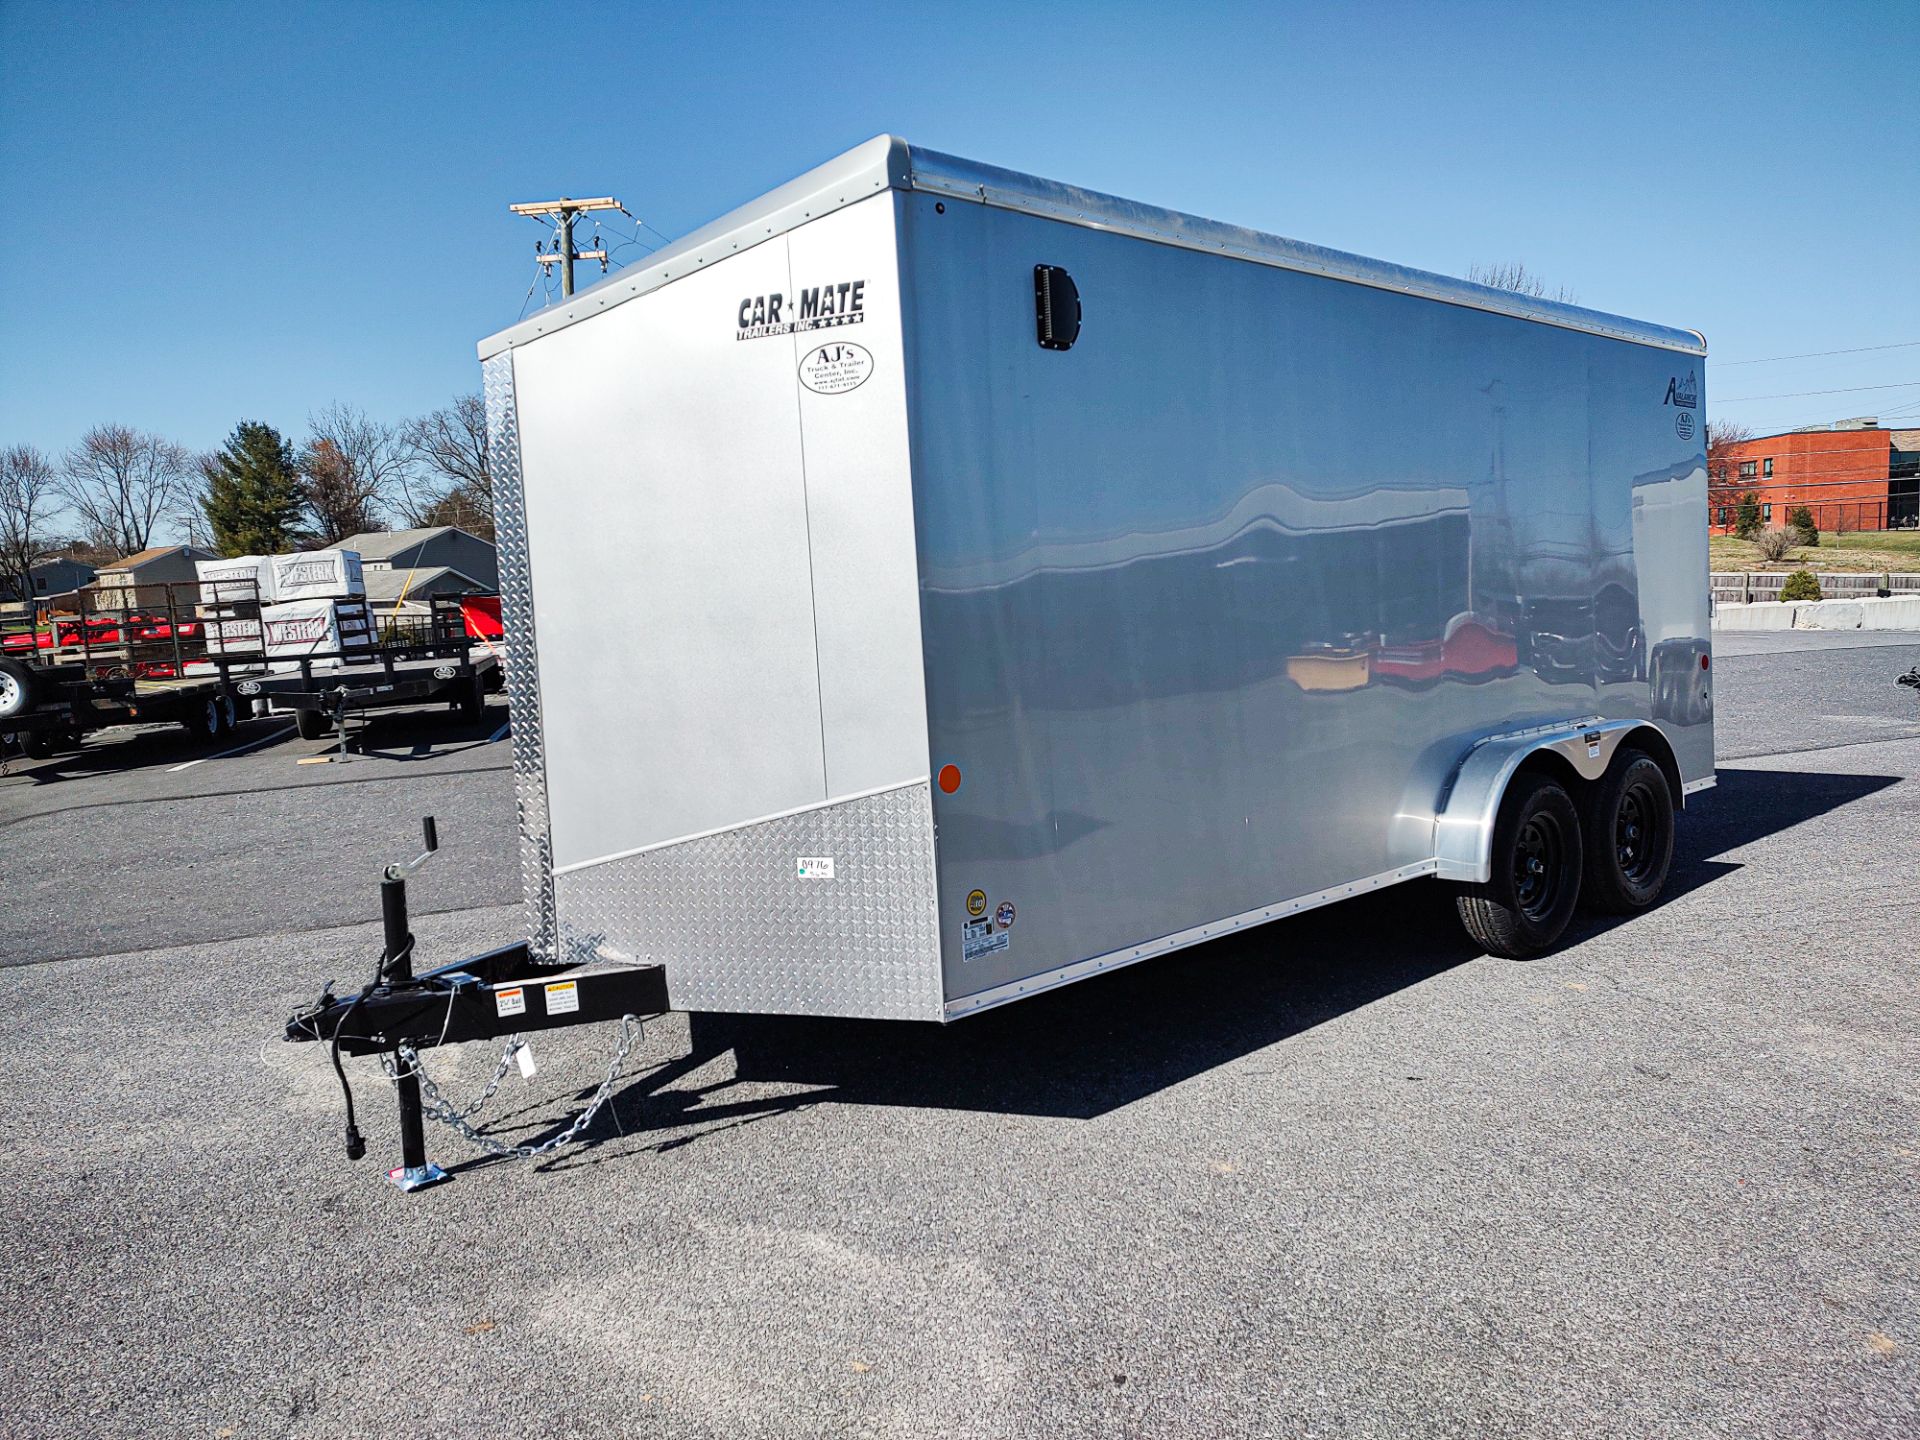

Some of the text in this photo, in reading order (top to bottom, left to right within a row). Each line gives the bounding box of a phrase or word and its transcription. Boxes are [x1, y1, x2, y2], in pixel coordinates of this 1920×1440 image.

[738, 280, 865, 328] CAR MATE
[738, 324, 791, 340] TRAILERS
[817, 345, 854, 364] AJ's
[270, 621, 324, 642] WESTERN
